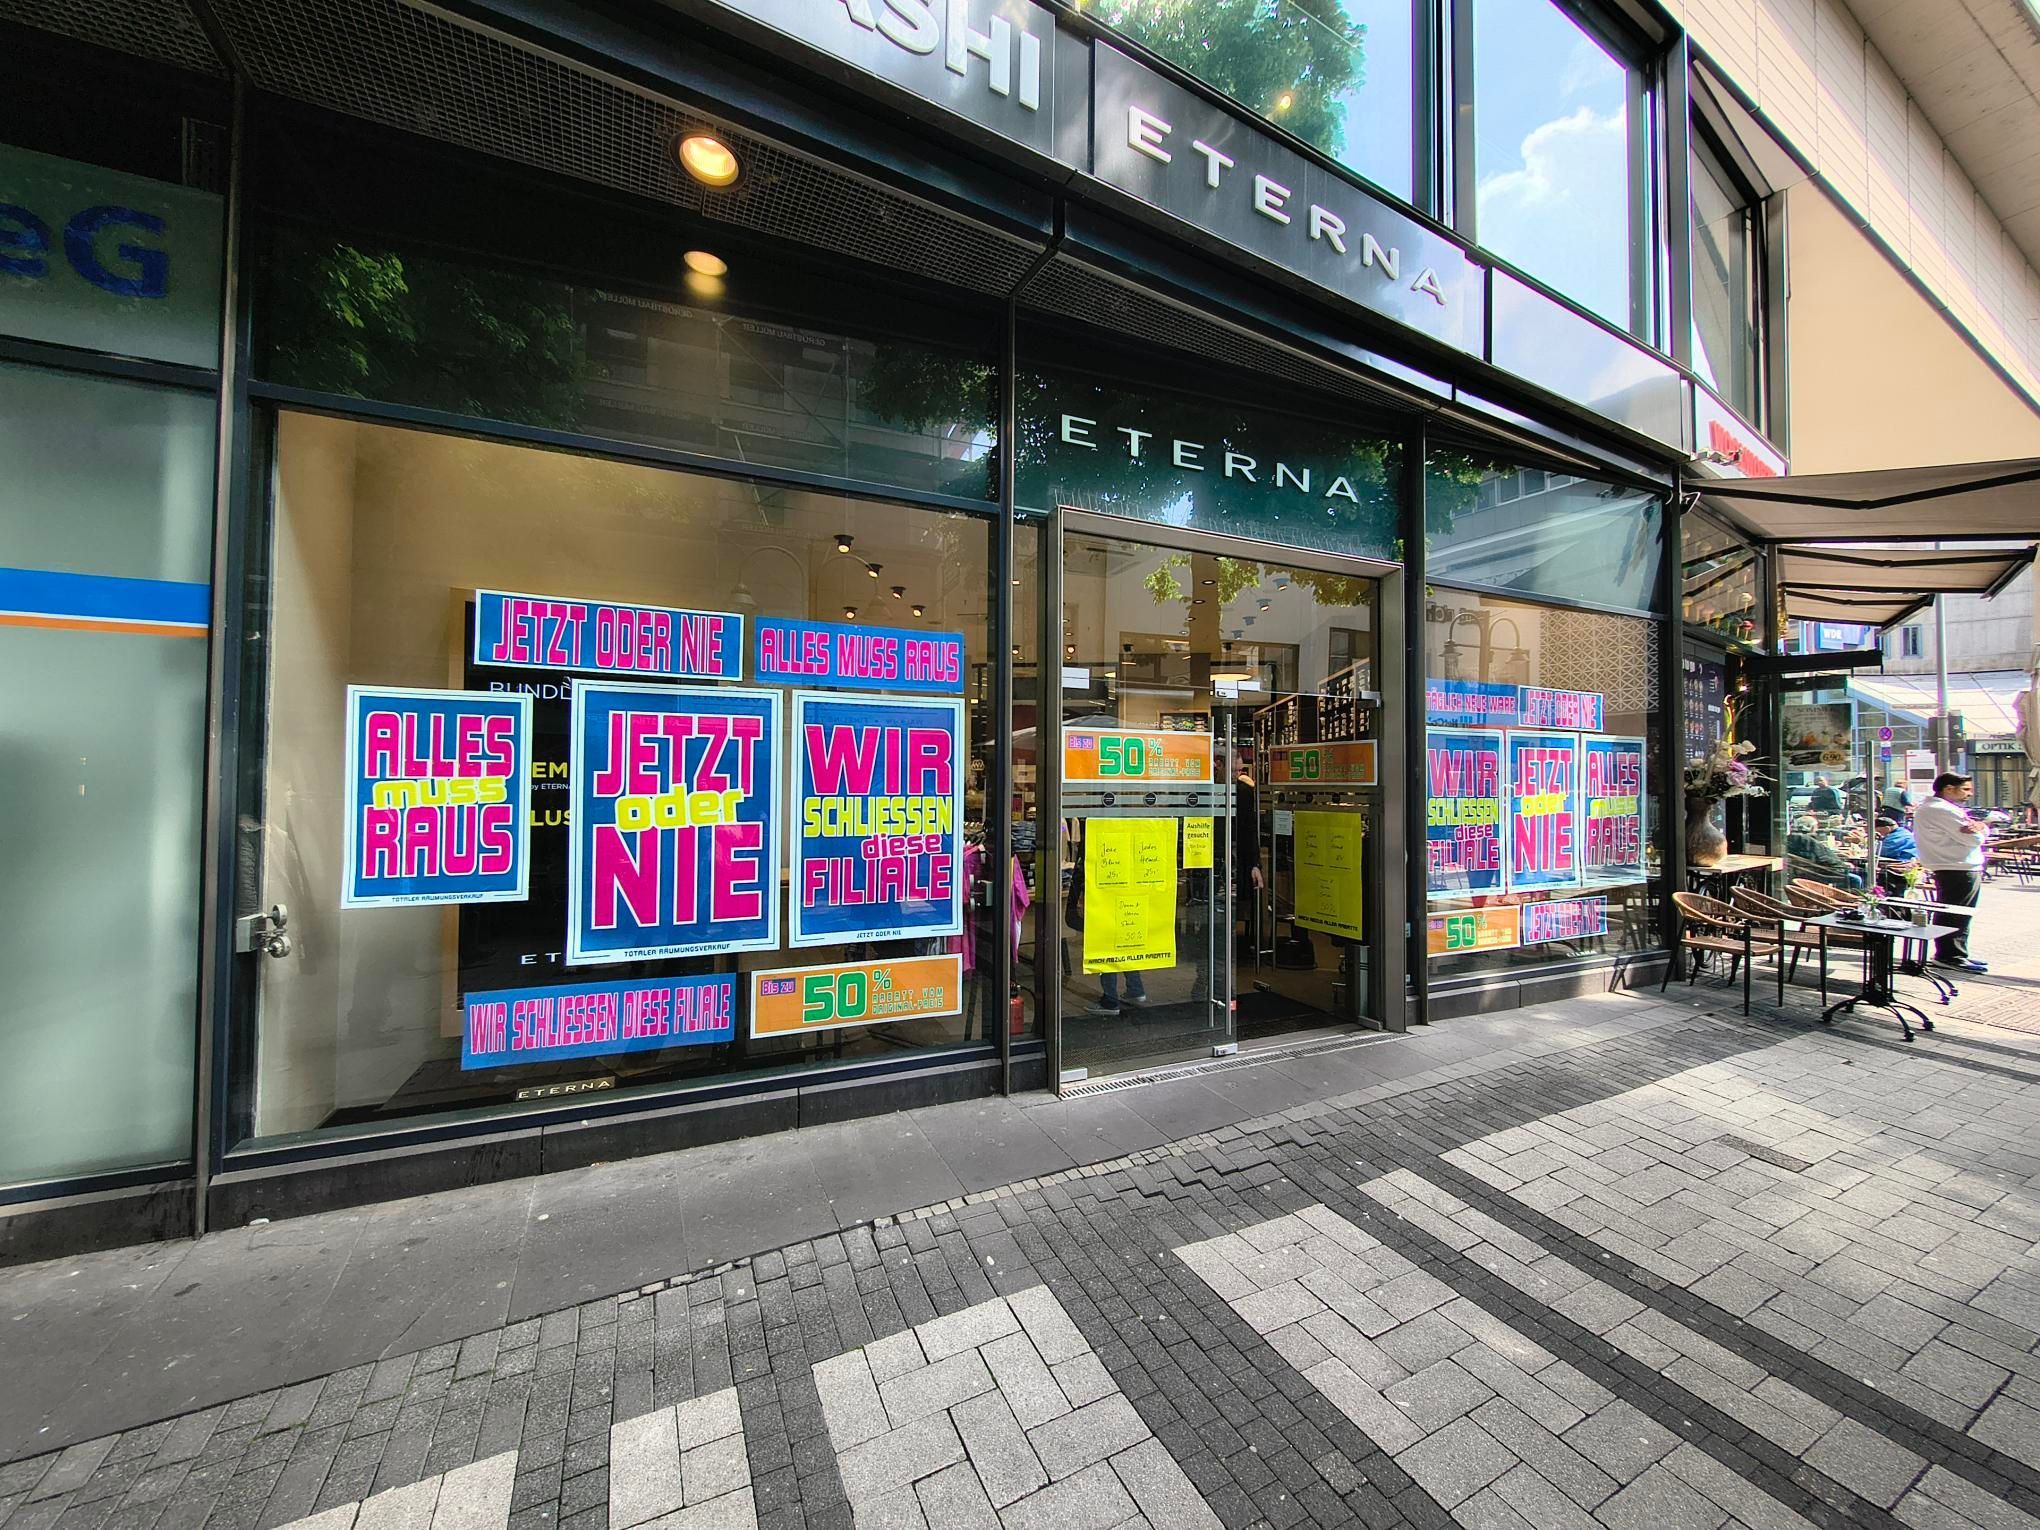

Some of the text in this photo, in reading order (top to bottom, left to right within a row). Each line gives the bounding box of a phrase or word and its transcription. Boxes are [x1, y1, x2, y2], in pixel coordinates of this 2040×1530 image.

[1127, 105, 1448, 305] ETERNA
[1061, 414, 1359, 503] ETERNA
[493, 597, 724, 675] JETZT ODER NIE
[761, 627, 960, 683] ALLES MUSS RAUS
[1465, 694, 1486, 714] NEUE
[1524, 689, 1597, 729] JETZT ODER NIE
[365, 711, 515, 779] ALLES
[593, 710, 763, 797] JETZT
[804, 724, 952, 795] WIR
[1098, 735, 1146, 777] 50
[1288, 748, 1320, 780] 50
[1982, 742, 2015, 750] OPTIK
[372, 776, 507, 810] muss
[1427, 748, 1498, 797] WIR
[1514, 747, 1573, 797] JETZT
[1587, 751, 1641, 797] ALLES
[615, 783, 744, 833] oder
[803, 797, 953, 838] SCHLIESSEN
[1428, 797, 1499, 826] SCHLIESSEN
[1520, 788, 1567, 817] oder
[361, 804, 513, 879] RAUS
[861, 833, 943, 860] diese
[1427, 837, 1500, 874] FILIALE
[1454, 823, 1494, 842] diese
[1513, 811, 1573, 874] NIE
[1586, 815, 1640, 867] RAUS
[591, 822, 763, 929] NIE
[803, 854, 951, 908] FILIALE
[1446, 915, 1476, 949] 50
[1529, 903, 1556, 941] JETZT
[1583, 899, 1601, 934] NIE
[624, 950, 657, 958] TOTALER
[470, 983, 731, 1055] WIR SCHLIESSEN DIESE FILIALE
[761, 968, 892, 1024] Bis zu 50 %
[518, 1080, 612, 1099] ETERNA
